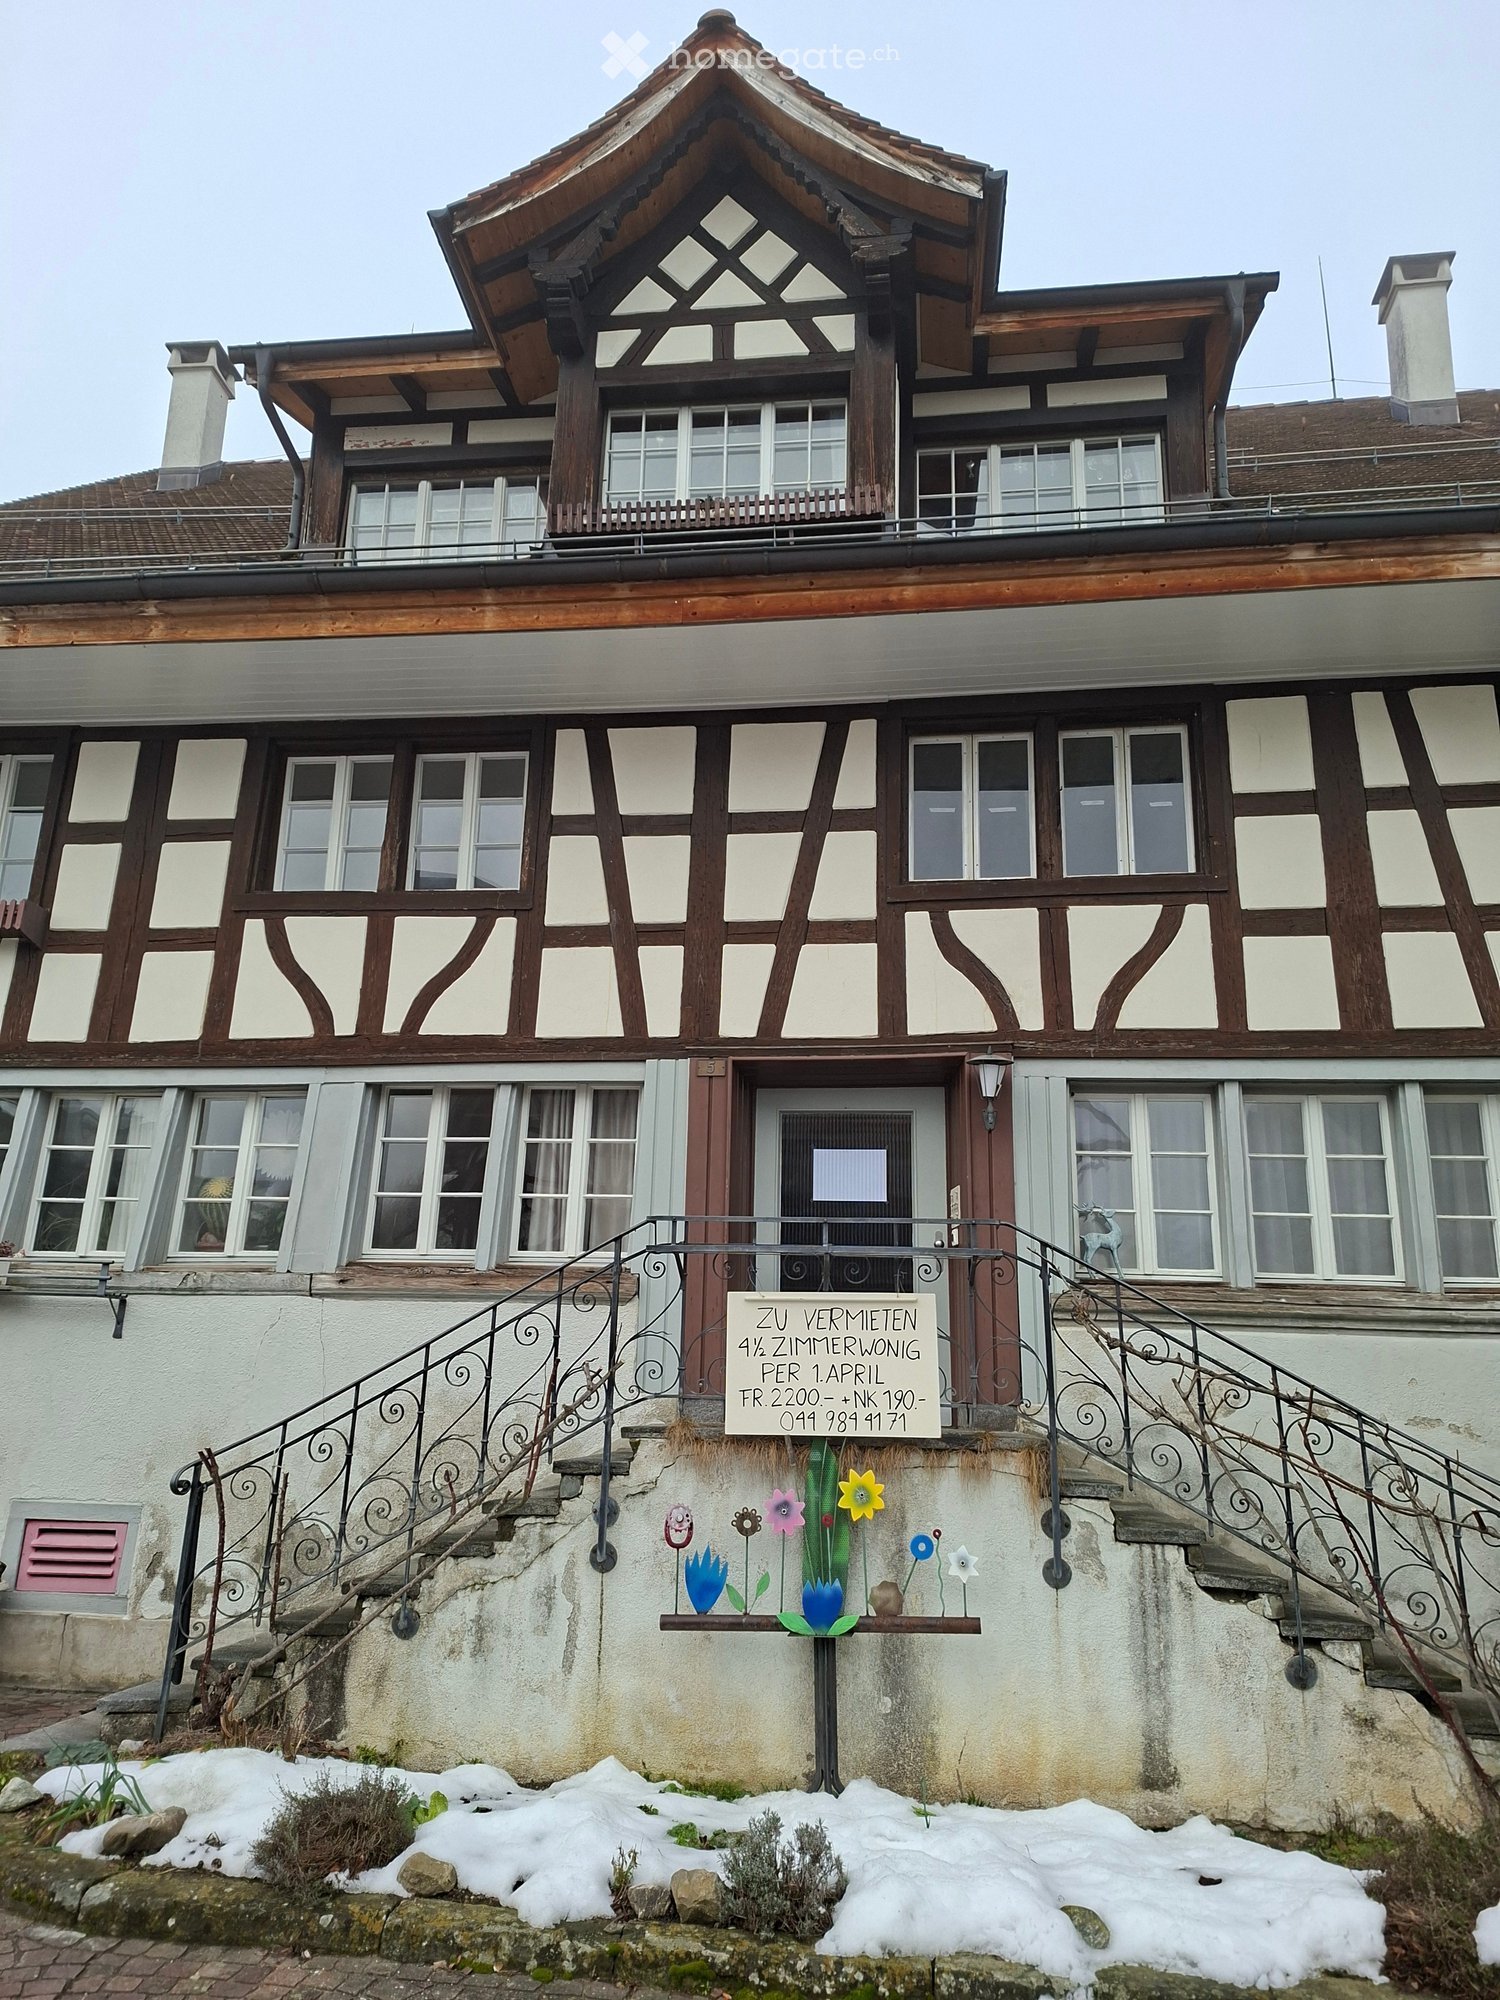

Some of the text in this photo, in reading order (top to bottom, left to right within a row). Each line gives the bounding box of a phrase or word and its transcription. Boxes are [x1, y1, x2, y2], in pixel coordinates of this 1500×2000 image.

[706, 1061, 715, 1074] 5
[756, 1307, 918, 1331] ZU VERMIETEN
[771, 1336, 921, 1360] ZIMMERWONIG
[761, 1362, 800, 1383] PER
[779, 1410, 816, 1432] 044
[826, 1410, 858, 1433] 984
